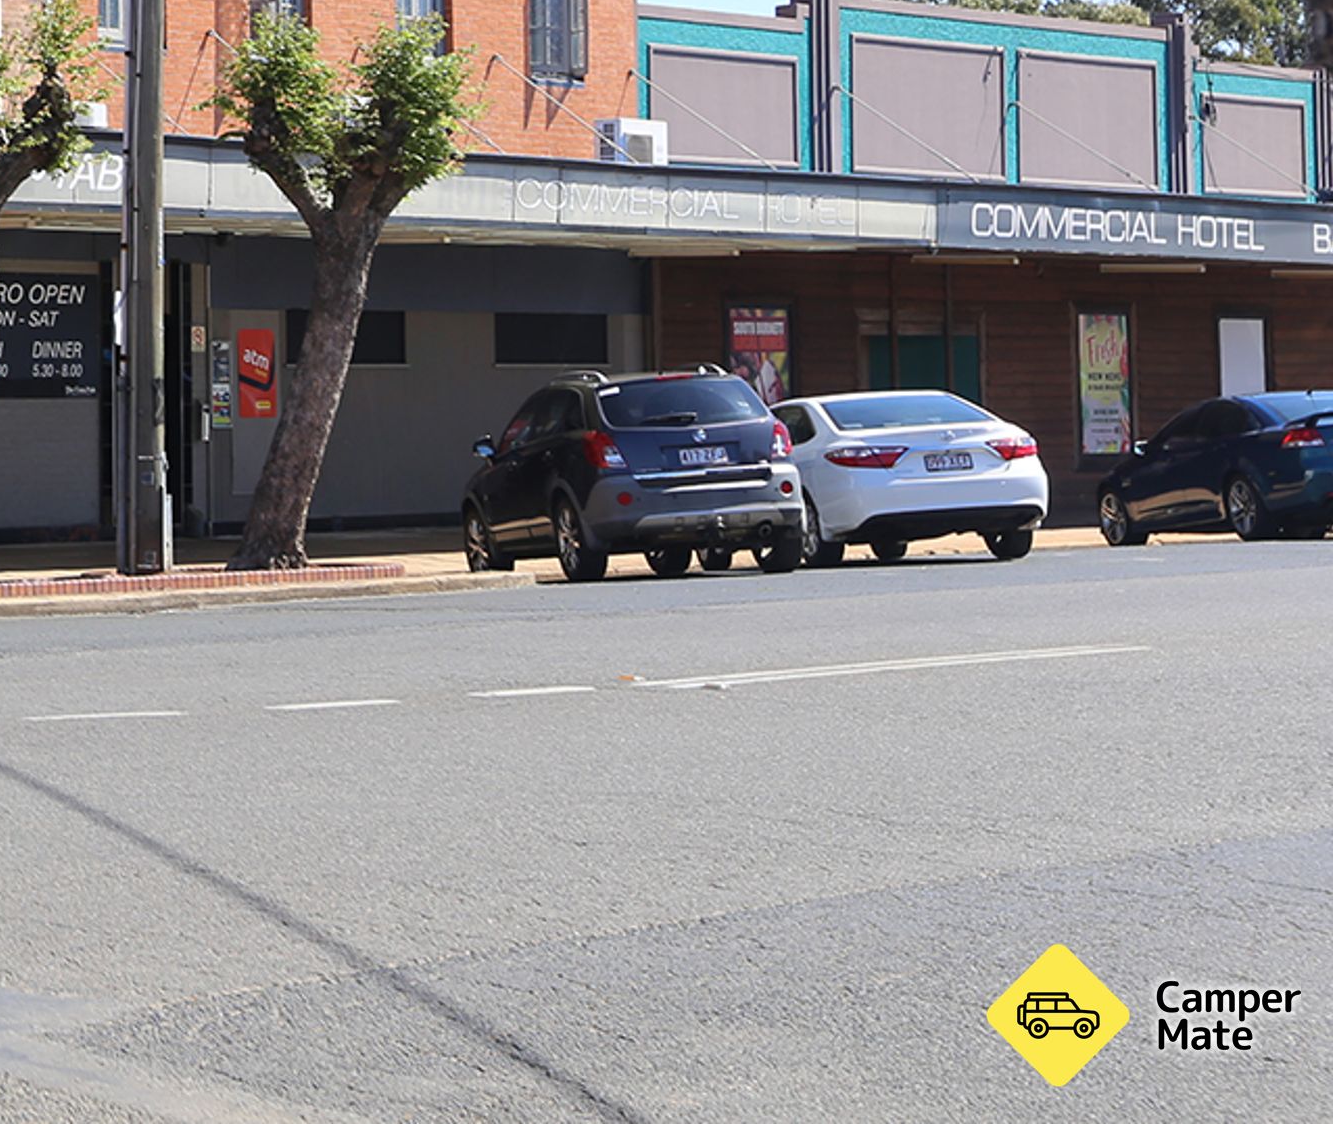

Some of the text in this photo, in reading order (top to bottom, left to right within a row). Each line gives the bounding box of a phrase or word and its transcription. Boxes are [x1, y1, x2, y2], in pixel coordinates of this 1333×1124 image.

[516, 178, 740, 220] COMMERCIAL
[971, 203, 1264, 251] COMMERCIAL HOTEL
[28, 283, 86, 304] OPEN
[28, 309, 60, 327] SAT
[32, 341, 83, 359] DINNER
[243, 348, 270, 370] atm
